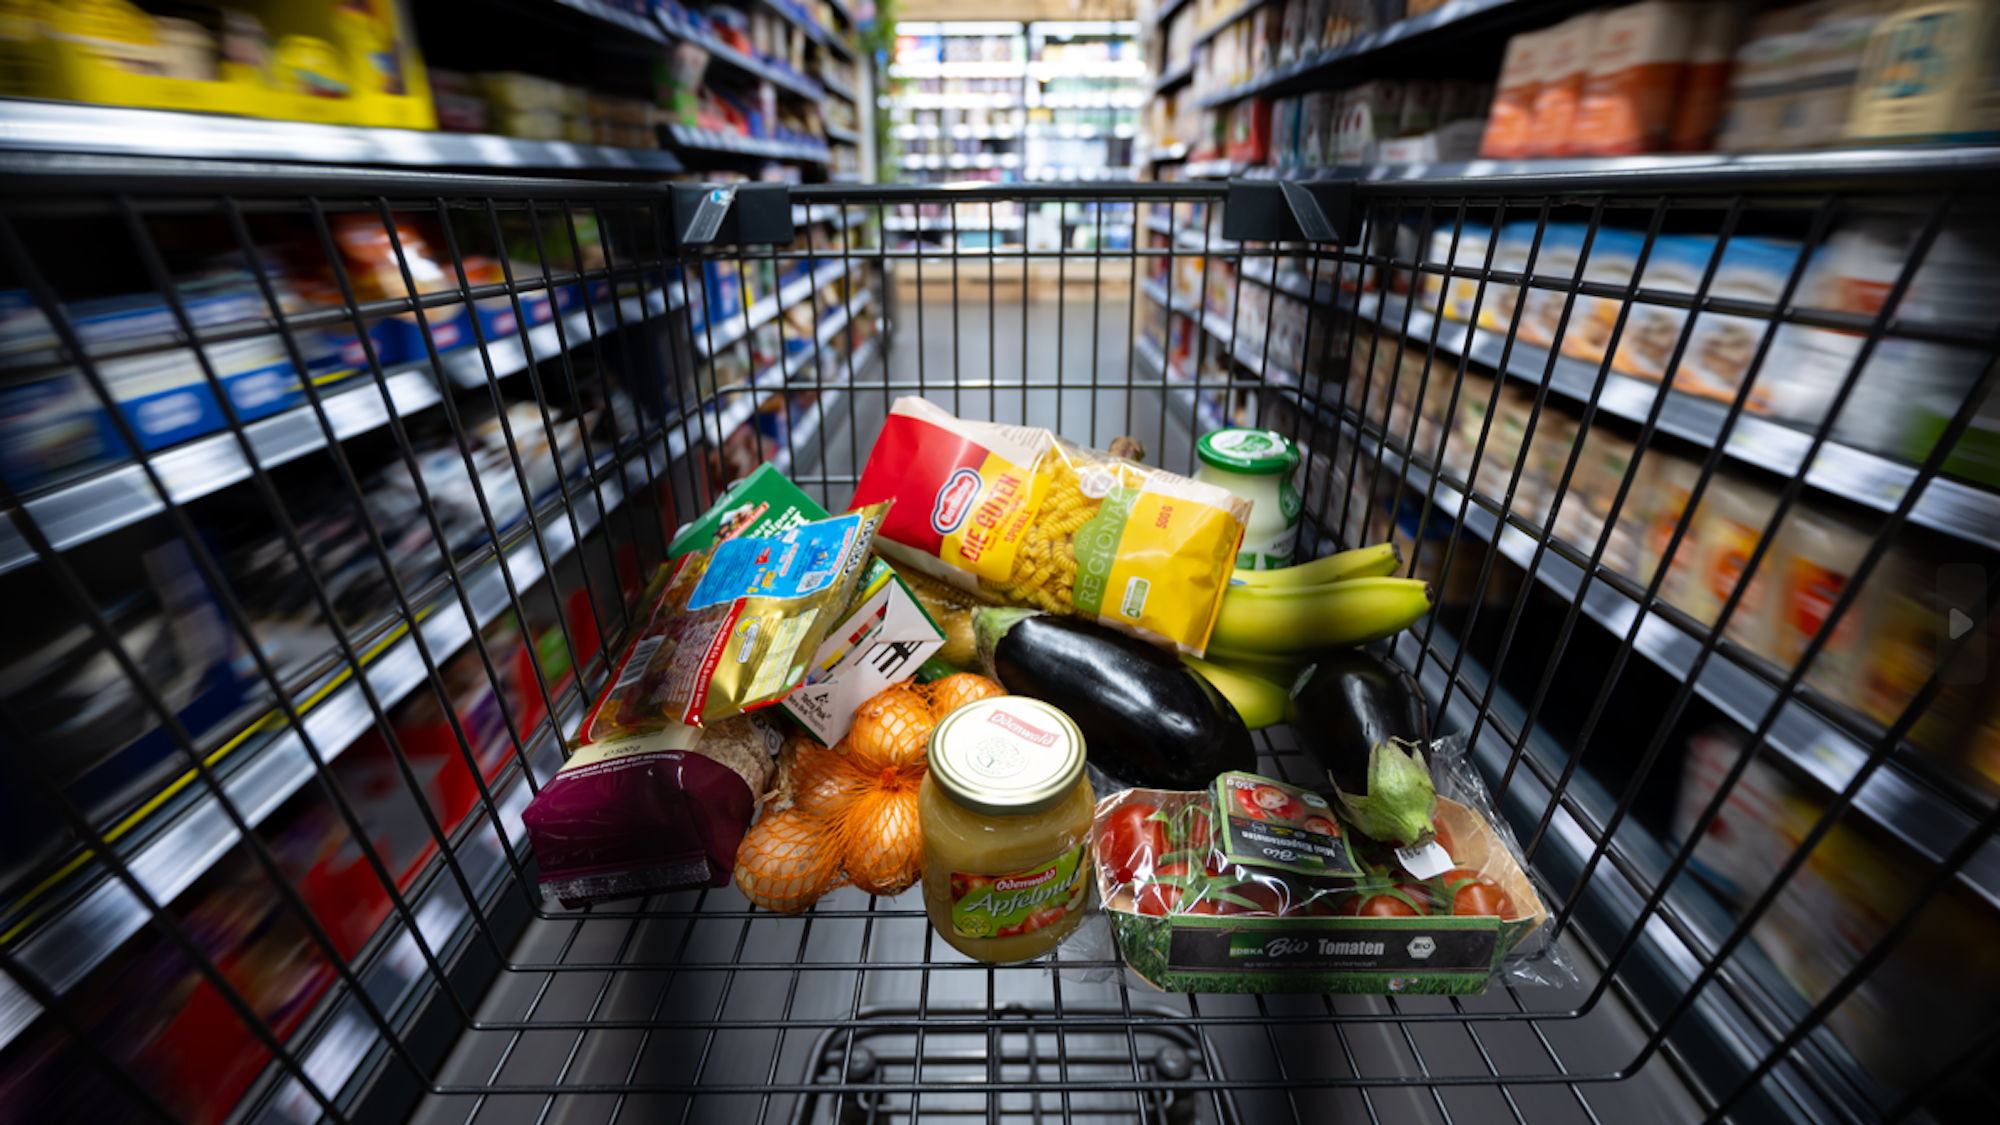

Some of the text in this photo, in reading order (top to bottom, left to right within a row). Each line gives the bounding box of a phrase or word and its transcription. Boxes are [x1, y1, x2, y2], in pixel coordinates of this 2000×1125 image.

[960, 528, 989, 563] DIE
[975, 473, 1022, 530] GUTEN
[1003, 508, 1034, 544] SPIRALE
[1079, 493, 1131, 605] REGIONAL
[800, 692, 817, 710] Tetra
[991, 713, 1055, 746] Odenwald
[1261, 844, 1297, 864] Bio
[995, 869, 1056, 892] Odenwald
[1230, 937, 1385, 958] EDEKA Bio Tomaten
